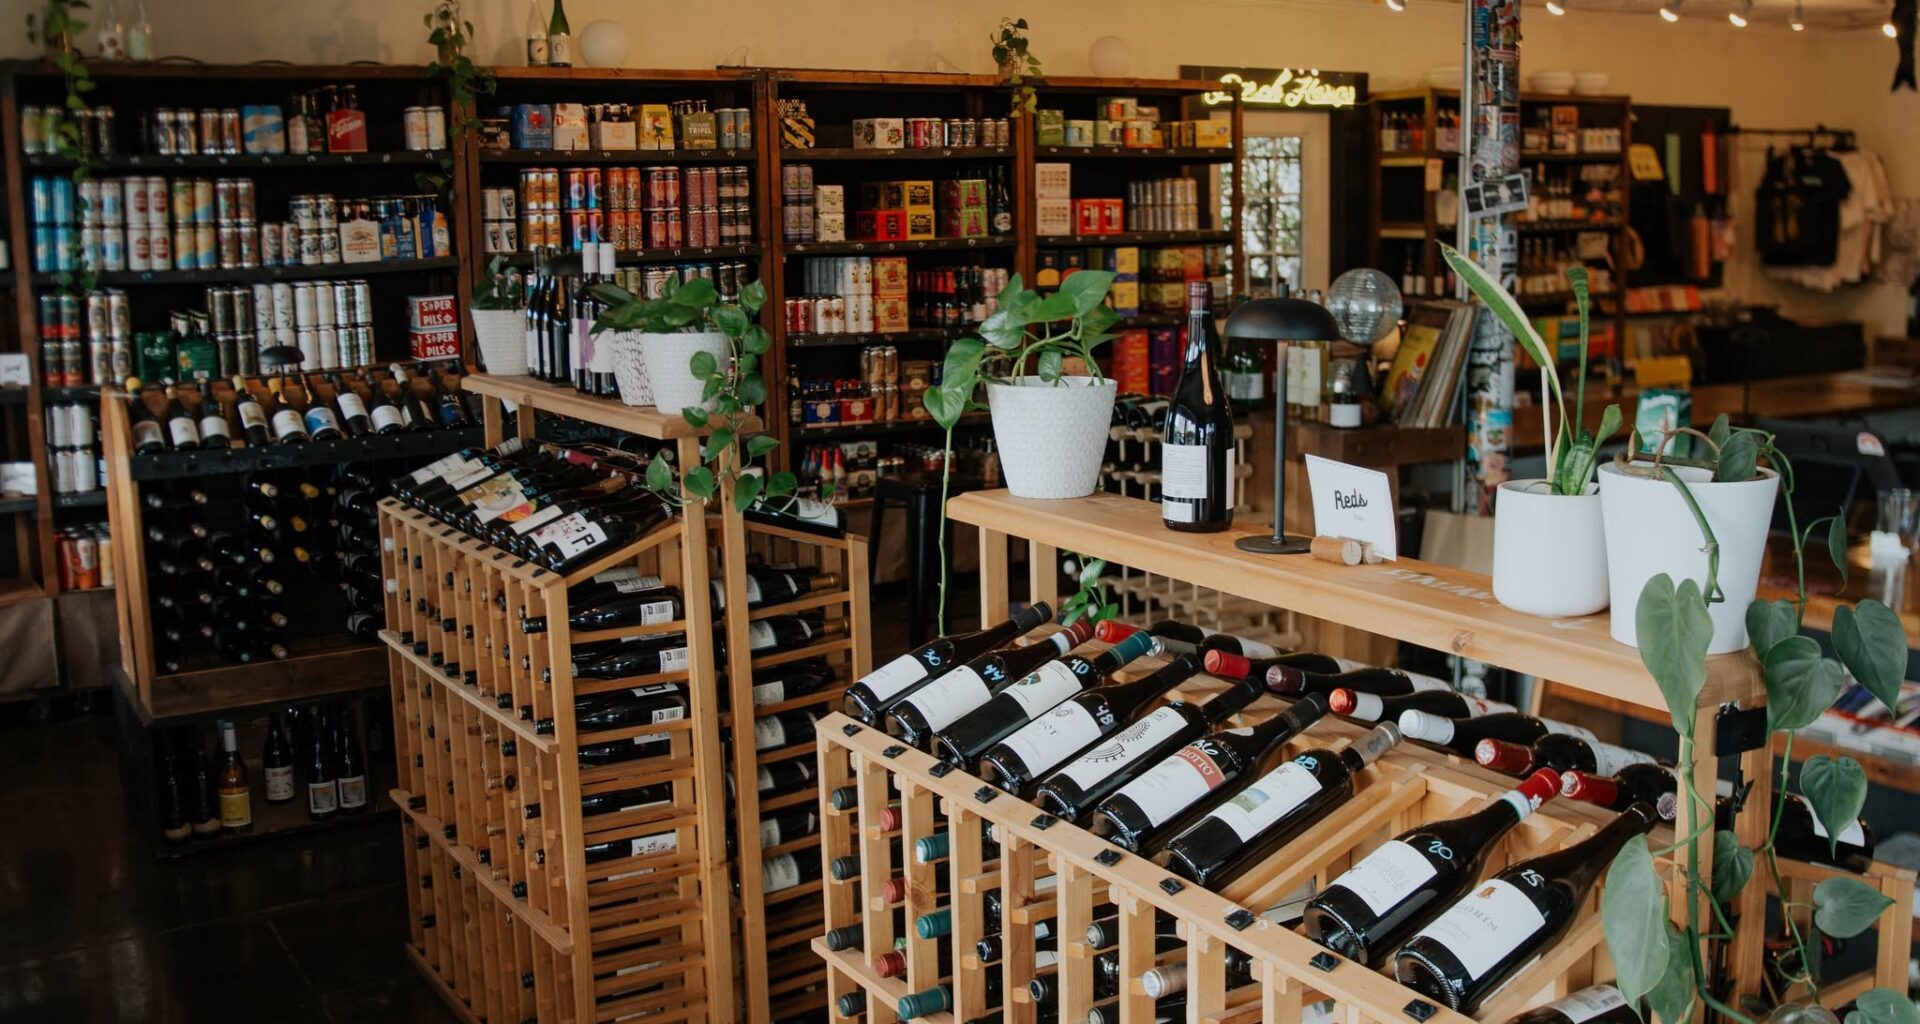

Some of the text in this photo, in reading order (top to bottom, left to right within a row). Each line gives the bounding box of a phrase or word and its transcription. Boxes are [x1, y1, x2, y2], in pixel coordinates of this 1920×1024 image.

[688, 127, 713, 135] TRIPEL
[1334, 487, 1369, 510] Reds
[1095, 705, 1115, 726] 48
[1428, 840, 1453, 860] 20
